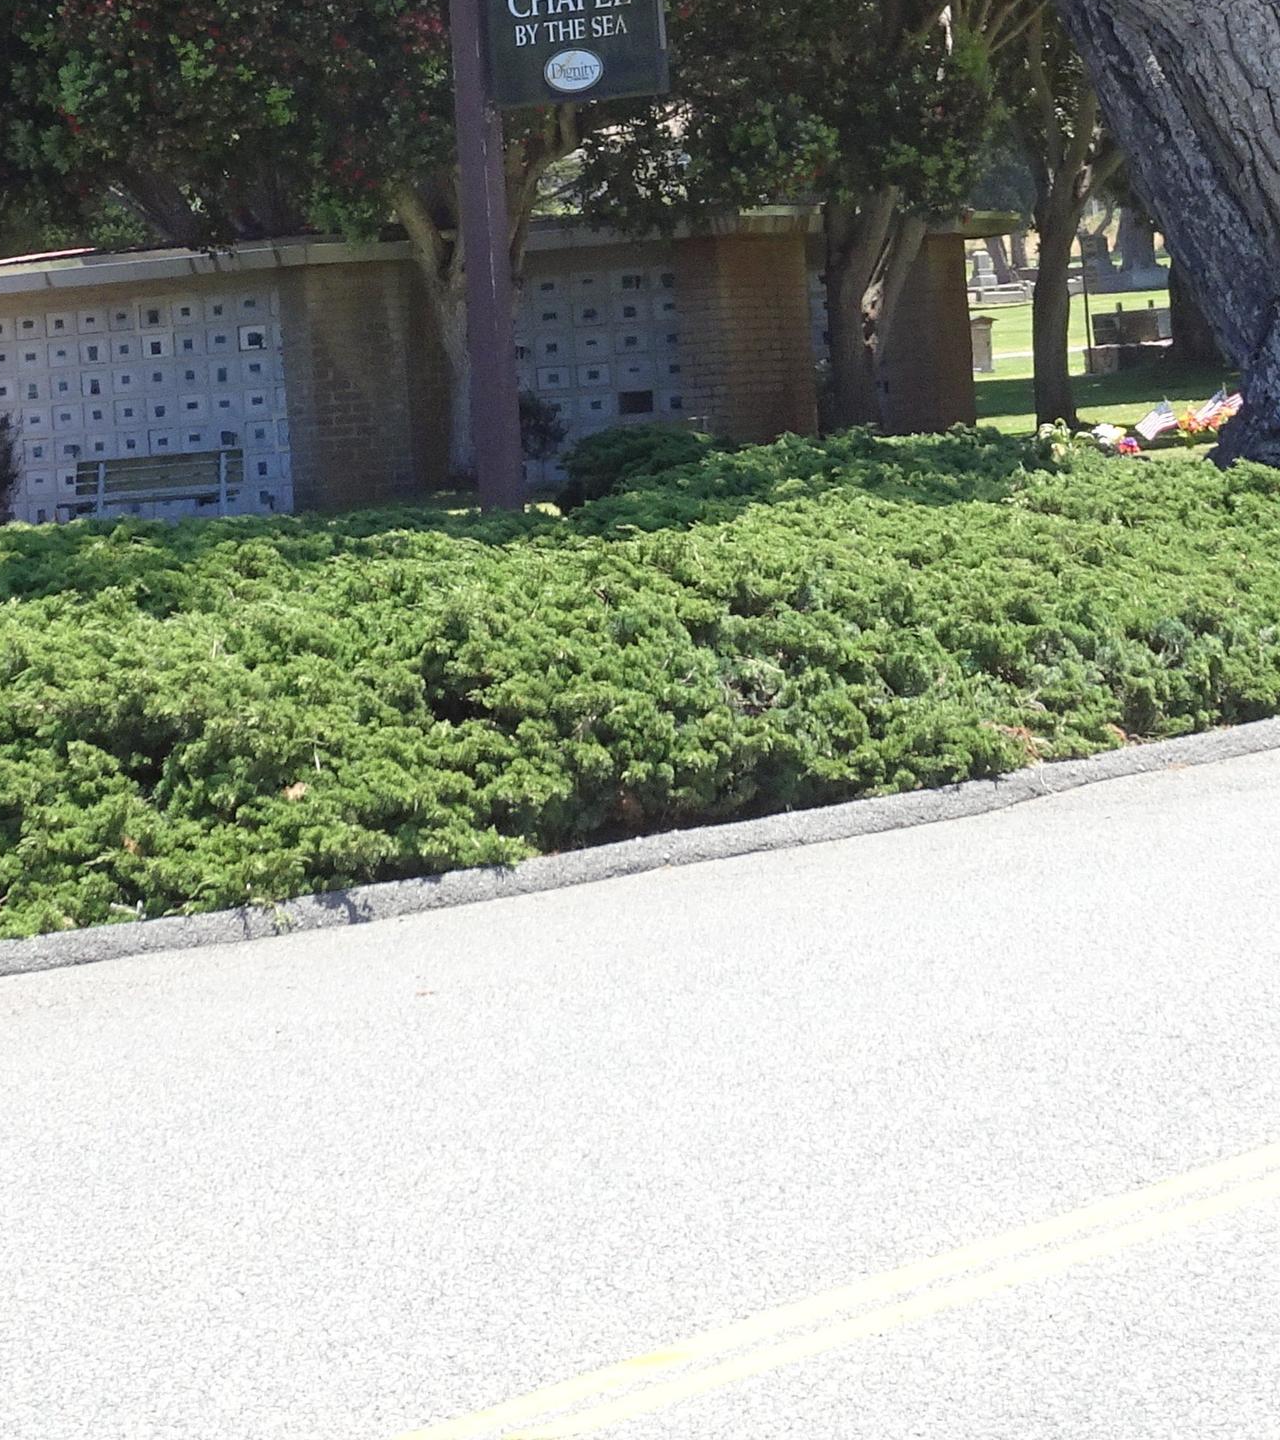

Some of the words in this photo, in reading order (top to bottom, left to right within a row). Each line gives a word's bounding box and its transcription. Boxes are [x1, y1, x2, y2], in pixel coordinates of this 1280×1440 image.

[515, 24, 538, 46] BY
[543, 18, 586, 42] THE
[592, 15, 628, 38] SEA
[551, 62, 596, 81] Dignity
